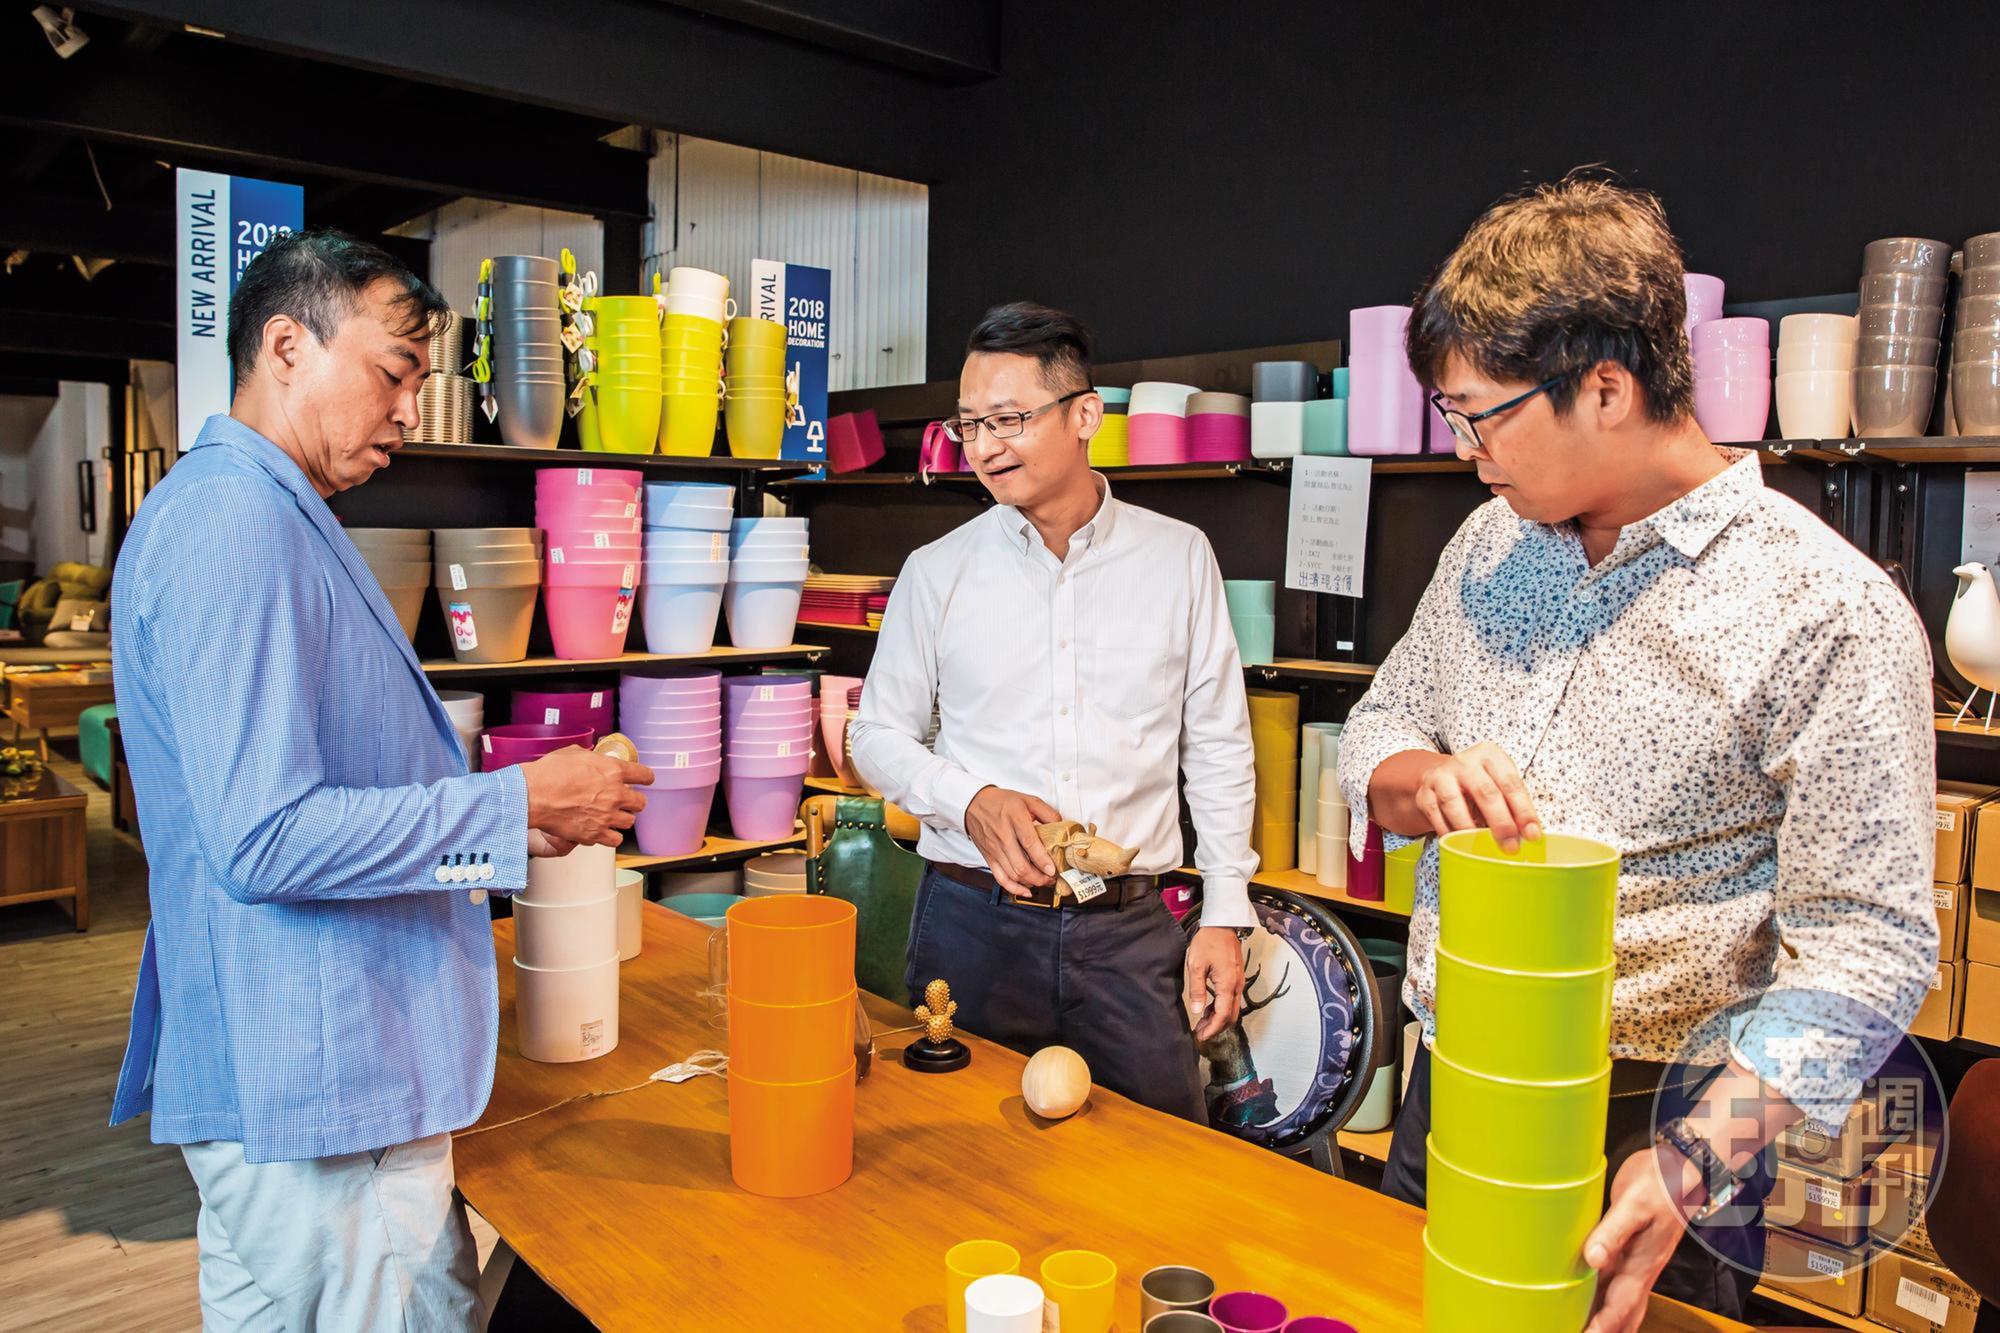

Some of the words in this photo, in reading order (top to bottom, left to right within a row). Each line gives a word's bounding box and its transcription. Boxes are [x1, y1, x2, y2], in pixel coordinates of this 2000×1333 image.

[191, 189, 216, 284] ARRIVAL
[191, 289, 216, 338] NEW
[788, 297, 825, 320] 2018
[788, 319, 826, 339] HOME
[786, 337, 825, 349] DECORATION
